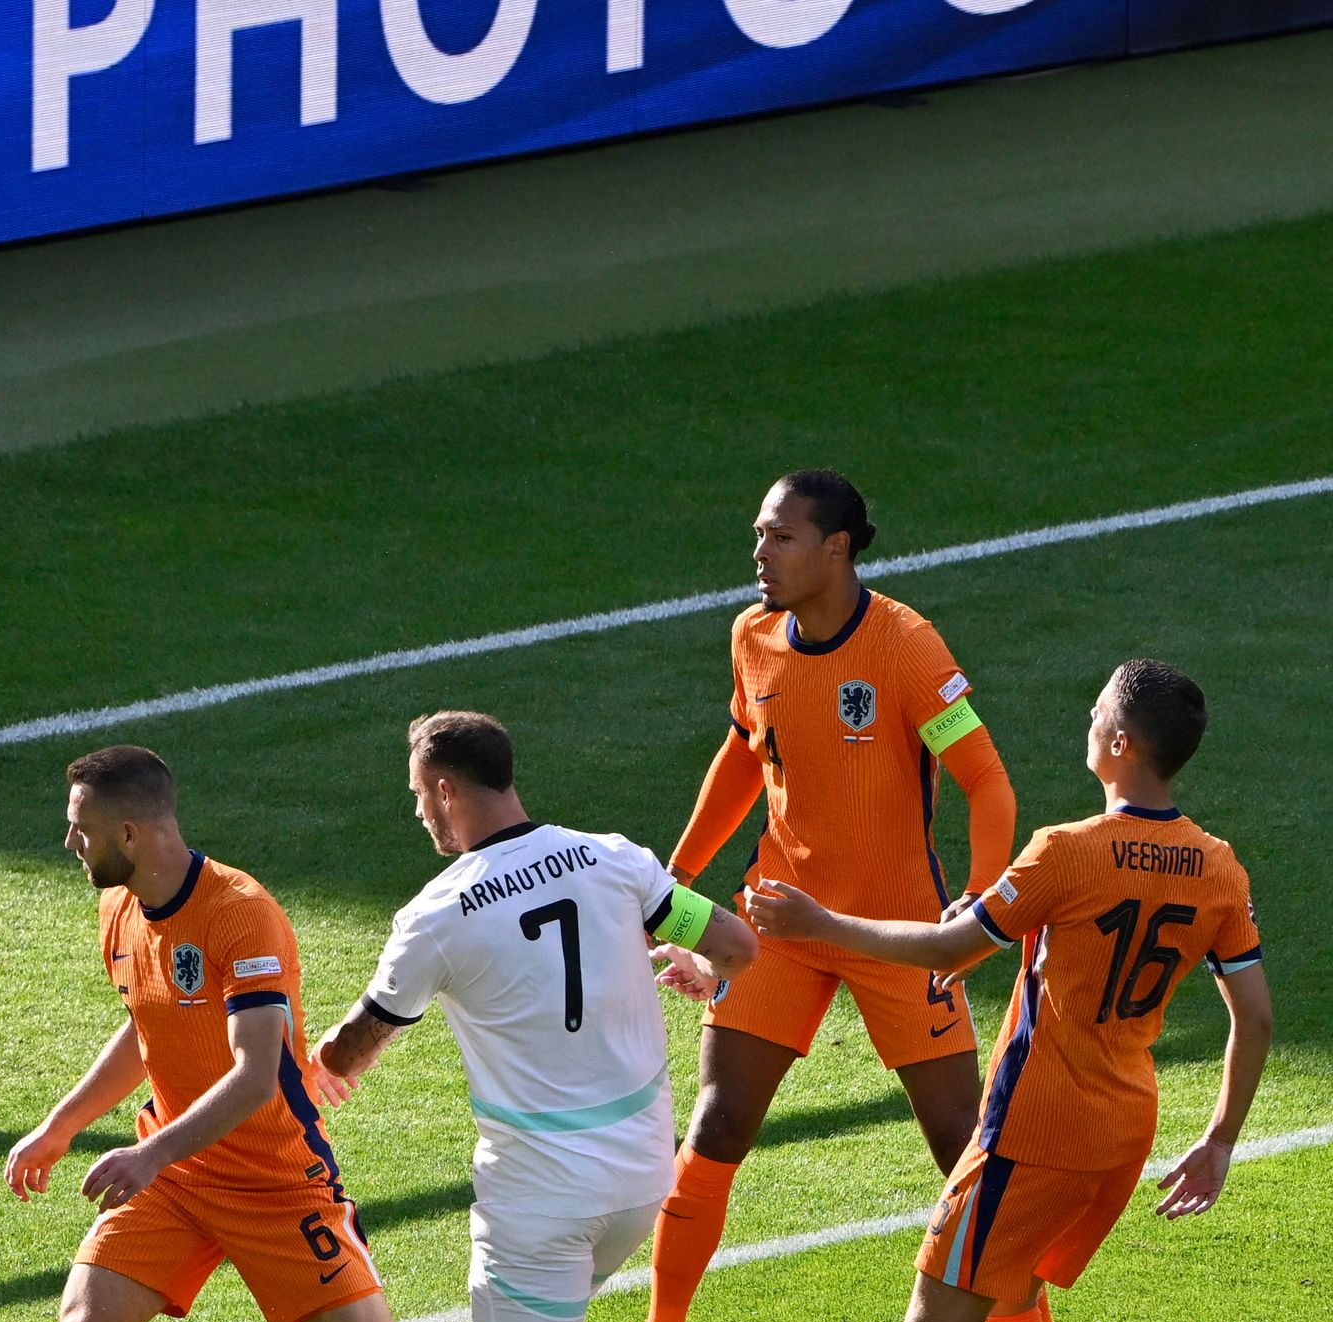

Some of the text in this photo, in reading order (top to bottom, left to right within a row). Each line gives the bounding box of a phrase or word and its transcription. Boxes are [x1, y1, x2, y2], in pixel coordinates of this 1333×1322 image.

[935, 706, 970, 733] RESPECT
[459, 845, 597, 916] ARNAUTOVIC
[1112, 840, 1204, 878] VEERMAN
[519, 898, 583, 1033] 7
[1094, 898, 1197, 1024] 16
[300, 1211, 341, 1261] 6
